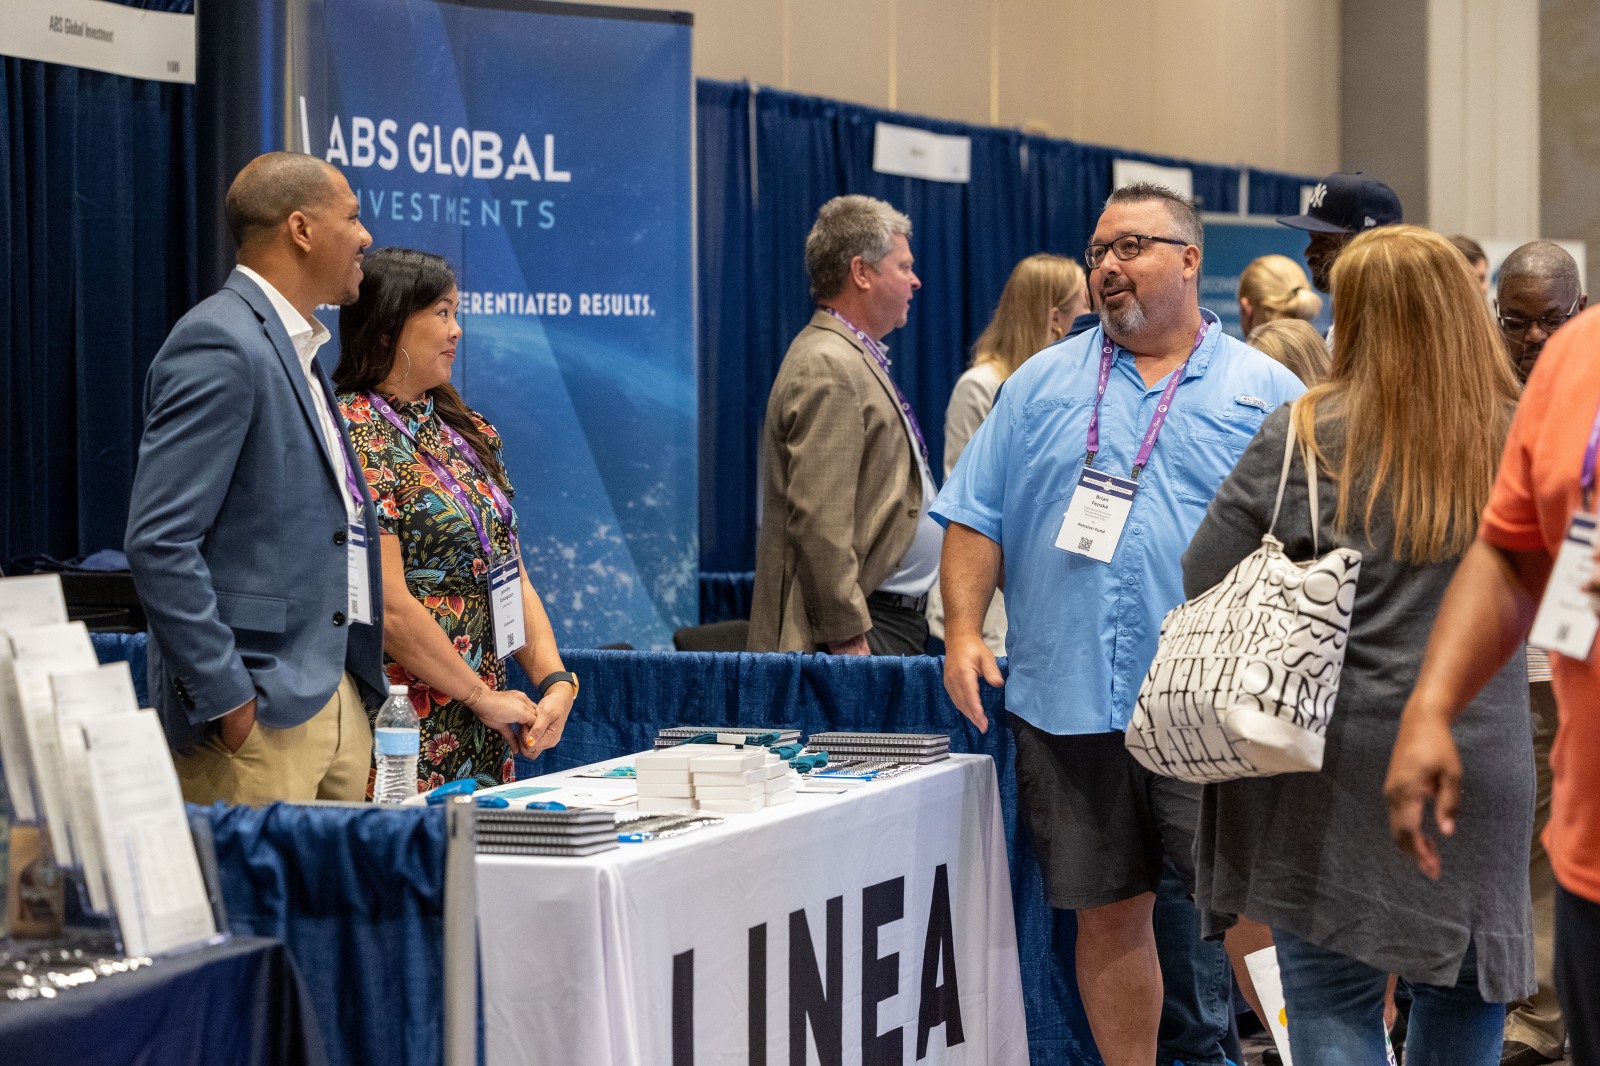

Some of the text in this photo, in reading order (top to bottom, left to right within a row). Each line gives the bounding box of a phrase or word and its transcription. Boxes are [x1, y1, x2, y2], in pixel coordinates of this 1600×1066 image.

[49, 15, 63, 34] ABS
[65, 18, 83, 36] Global
[326, 114, 571, 183] ABS GLOBAL
[357, 189, 555, 229] VESTMENTS
[457, 291, 656, 316] ERENTIATED RESULTS.
[1146, 428, 1157, 445] William
[1095, 494, 1109, 503] Brian
